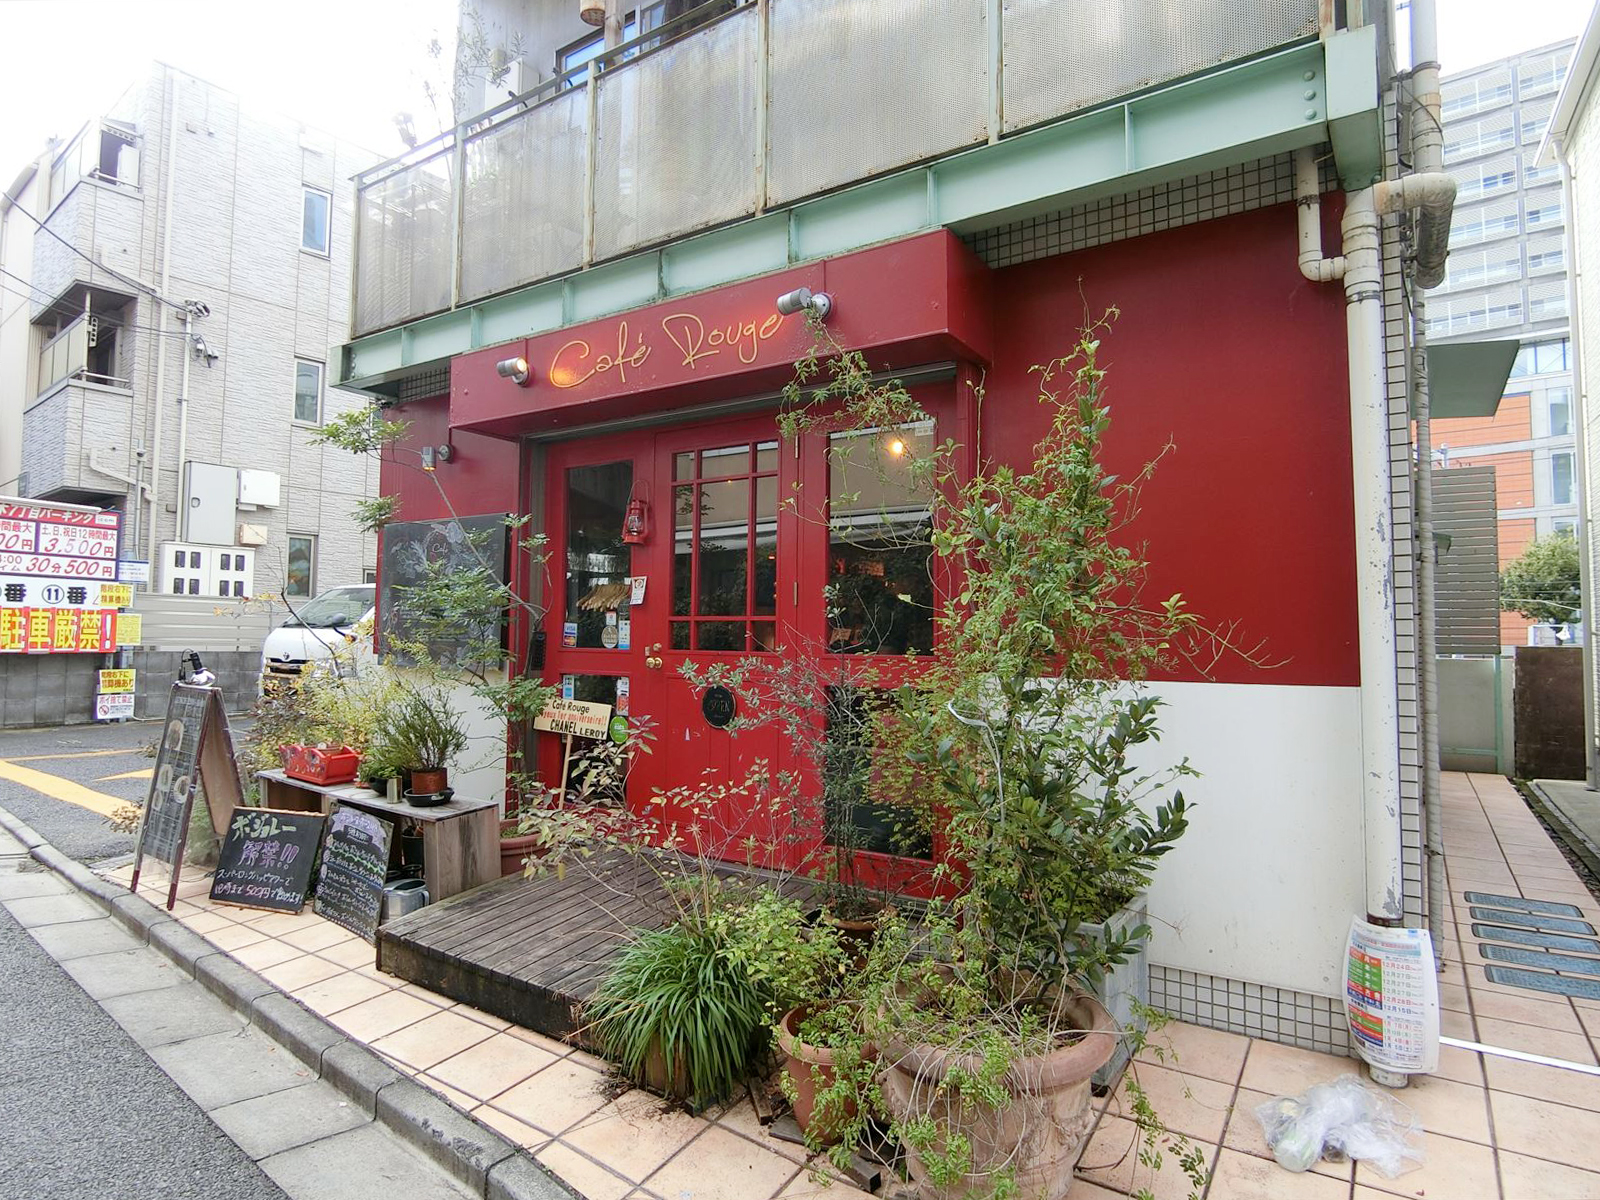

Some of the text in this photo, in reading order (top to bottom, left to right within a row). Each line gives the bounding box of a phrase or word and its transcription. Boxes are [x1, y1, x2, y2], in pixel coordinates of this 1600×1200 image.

[550, 313, 784, 388] Café Rouge
[568, 702, 590, 715] Rouge
[550, 718, 578, 735] CHANEL
[579, 727, 606, 739] LEROY
[231, 812, 297, 841] ボジョレー
